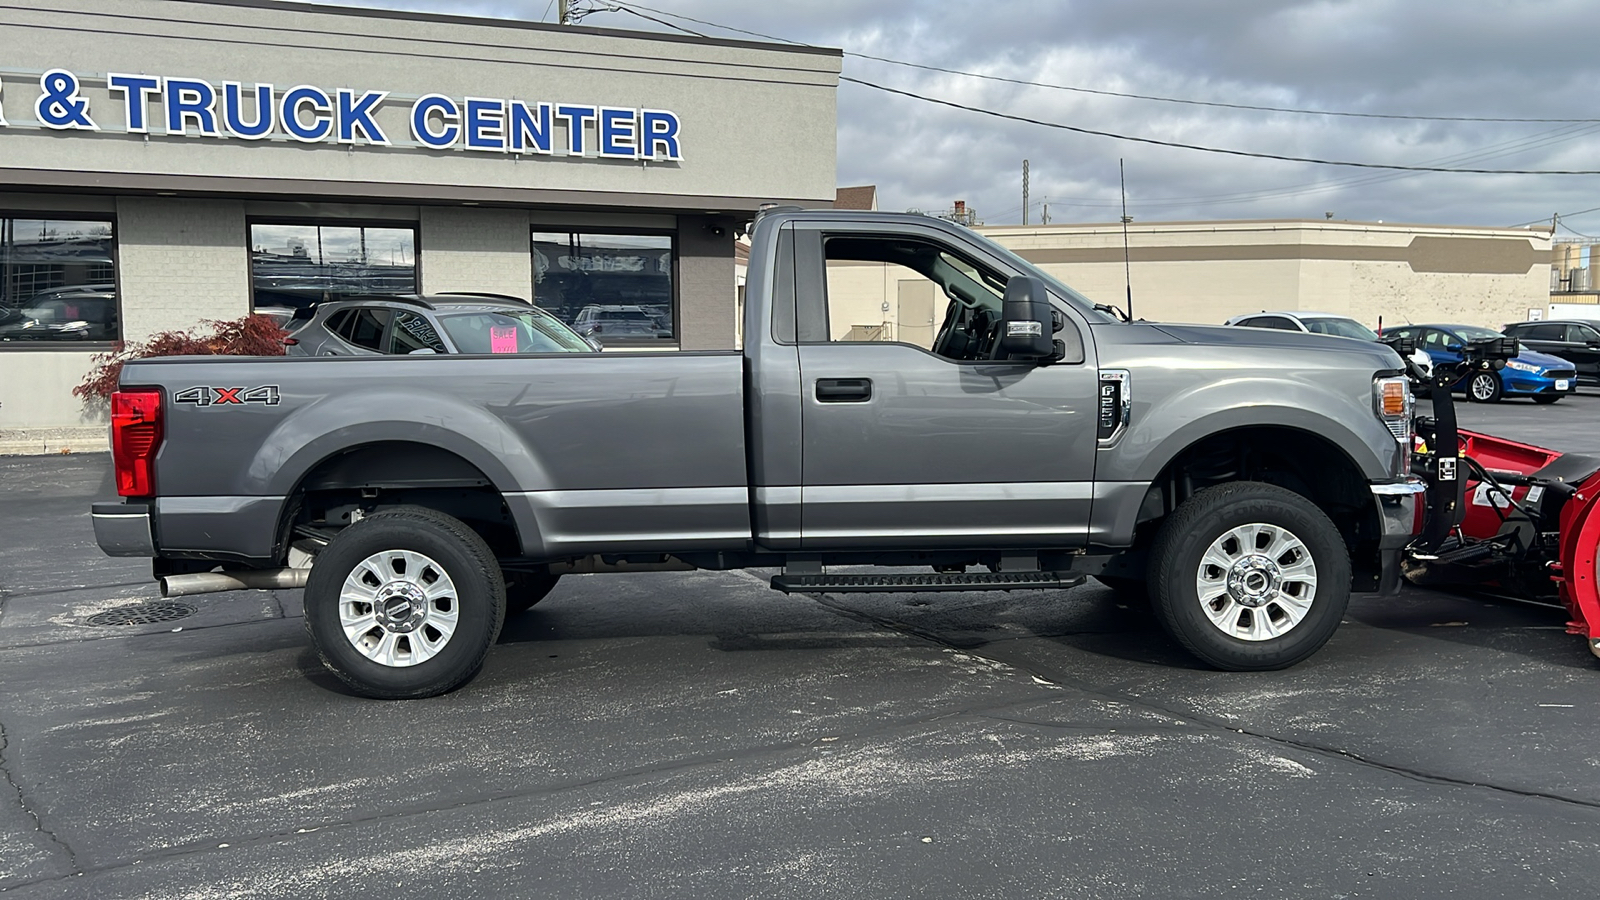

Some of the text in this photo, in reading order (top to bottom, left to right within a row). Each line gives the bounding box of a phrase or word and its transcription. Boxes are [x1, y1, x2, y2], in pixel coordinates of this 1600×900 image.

[34, 68, 100, 130] &
[107, 71, 391, 146] TRUCK
[410, 93, 685, 162] CENTER
[493, 330, 514, 340] SALE
